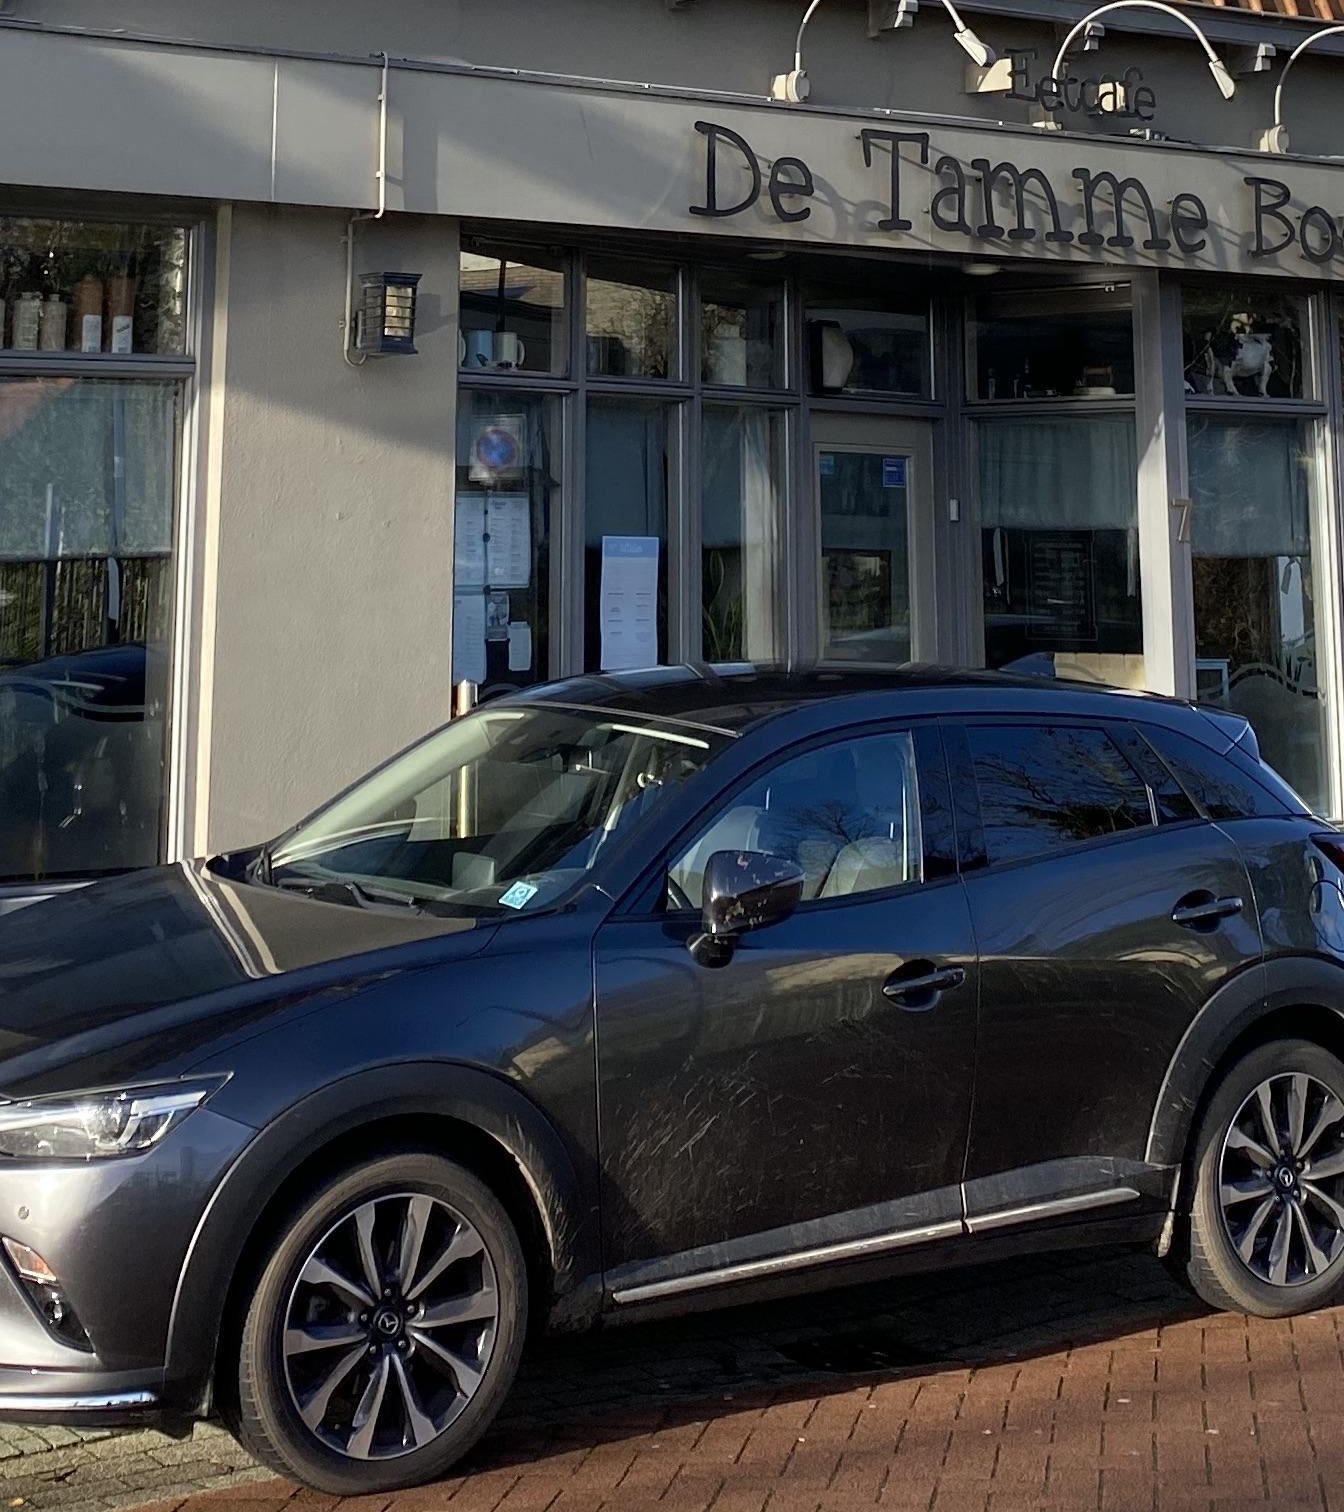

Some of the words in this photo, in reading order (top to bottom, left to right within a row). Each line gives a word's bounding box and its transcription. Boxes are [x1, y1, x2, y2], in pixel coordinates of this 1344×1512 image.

[688, 120, 815, 223] De
[860, 128, 1208, 253] Tamme
[1172, 498, 1192, 543] 7
